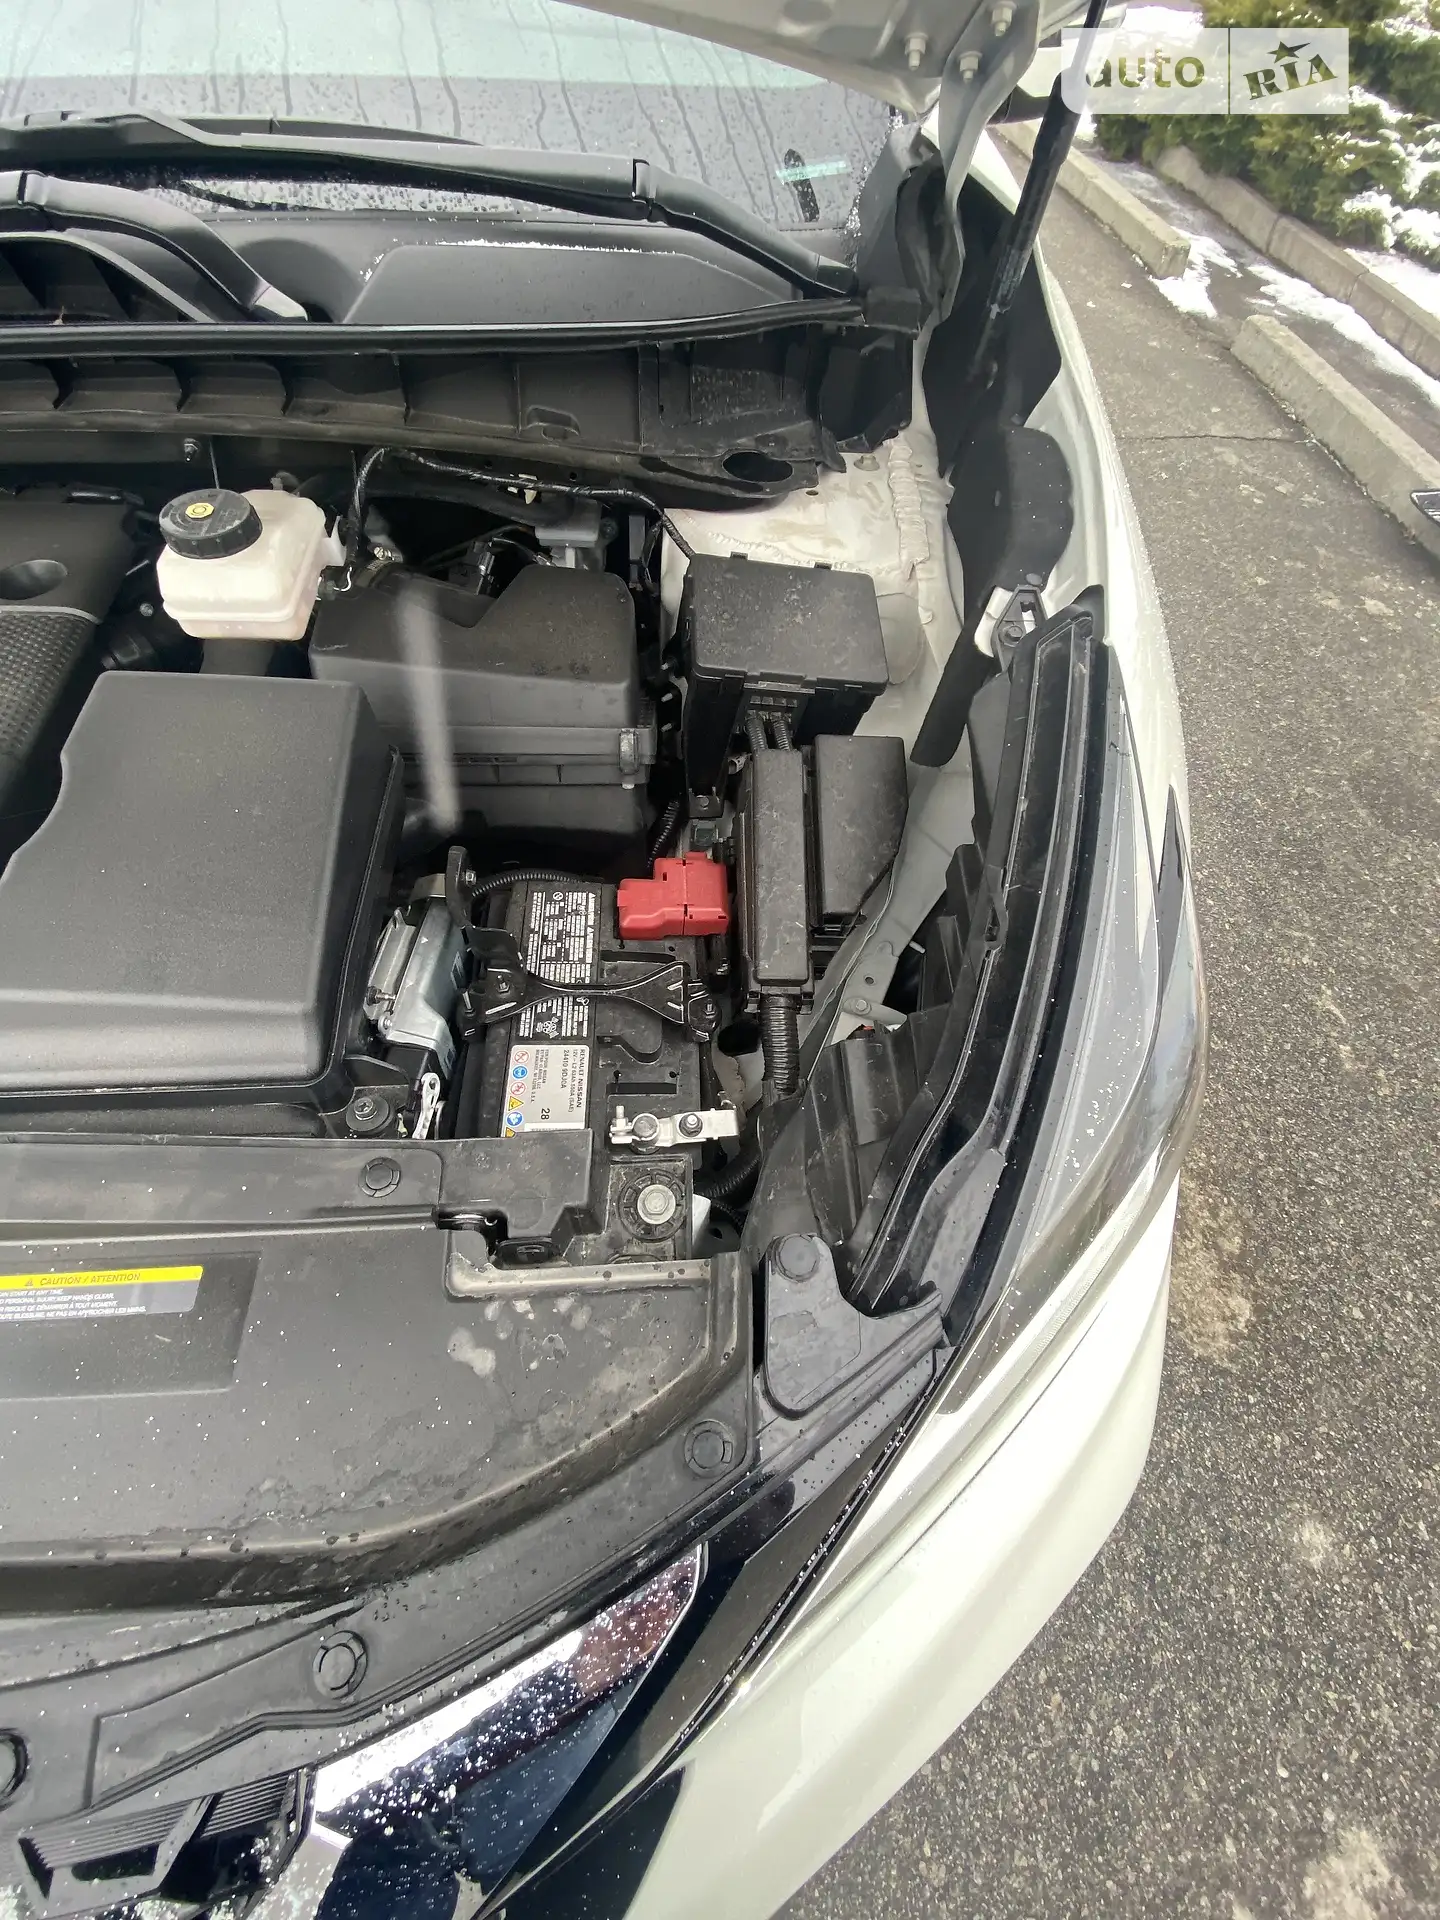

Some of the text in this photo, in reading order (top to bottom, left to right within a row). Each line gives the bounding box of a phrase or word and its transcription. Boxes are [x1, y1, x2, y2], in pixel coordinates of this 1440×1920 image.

[540, 1107, 550, 1120] 28
[40, 1276, 80, 1286] CAUTION
[90, 1273, 141, 1283] ATTENTION
